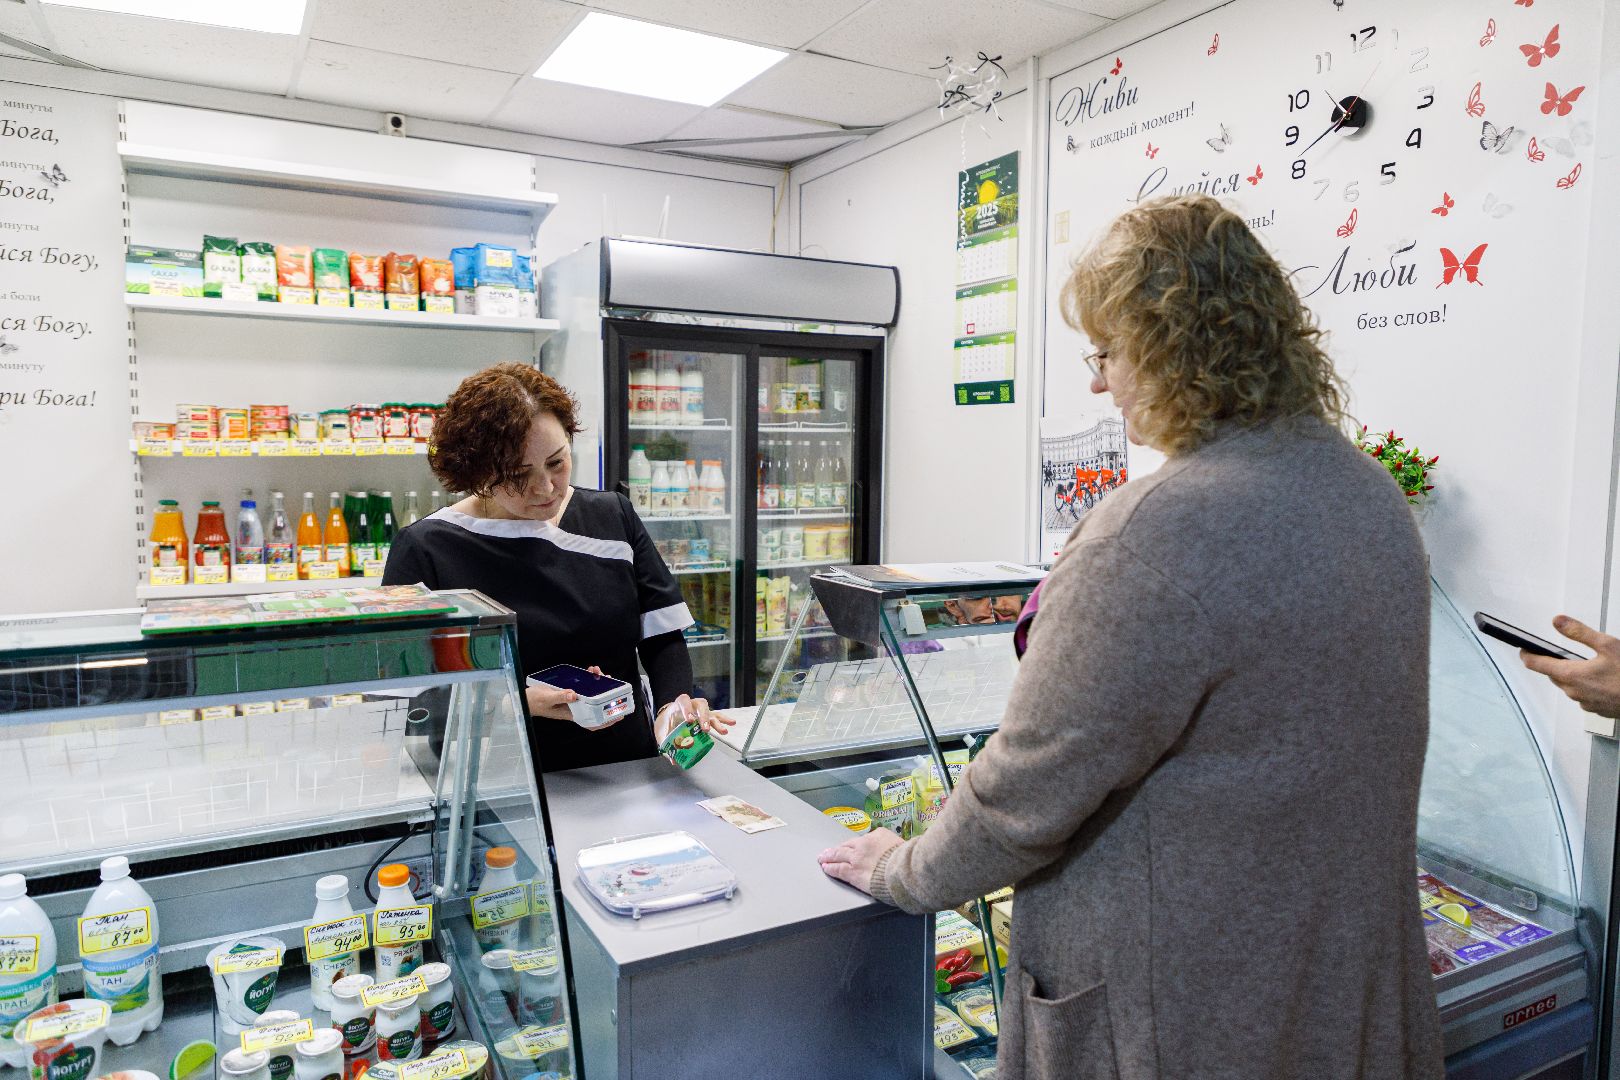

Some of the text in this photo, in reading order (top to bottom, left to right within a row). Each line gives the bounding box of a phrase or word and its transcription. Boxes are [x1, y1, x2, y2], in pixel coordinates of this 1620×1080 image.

[1350, 26, 1376, 53] 12
[1315, 52, 1331, 74] 11
[1409, 47, 1429, 73] 2
[3, 100, 53, 113] минуты
[1055, 77, 1138, 127] Живи
[1288, 89, 1310, 112] 10
[1417, 86, 1434, 110] 3
[1, 119, 60, 145] Бога,
[1090, 101, 1195, 149] каждый момент!
[1285, 126, 1299, 146] 9
[1405, 128, 1421, 148] 4
[1291, 159, 1306, 179] 8
[1380, 162, 1396, 186] 5
[1313, 179, 1330, 200] 7
[1343, 181, 1360, 202] 6
[976, 201, 999, 219] 2025
[40, 247, 99, 272] Богу,
[1286, 240, 1418, 299] Люби
[33, 315, 92, 340] Богу.
[1357, 304, 1447, 329] без слов!
[33, 389, 96, 408] Бога!
[112, 930, 131, 947] 87
[101, 976, 122, 986] ТАН
